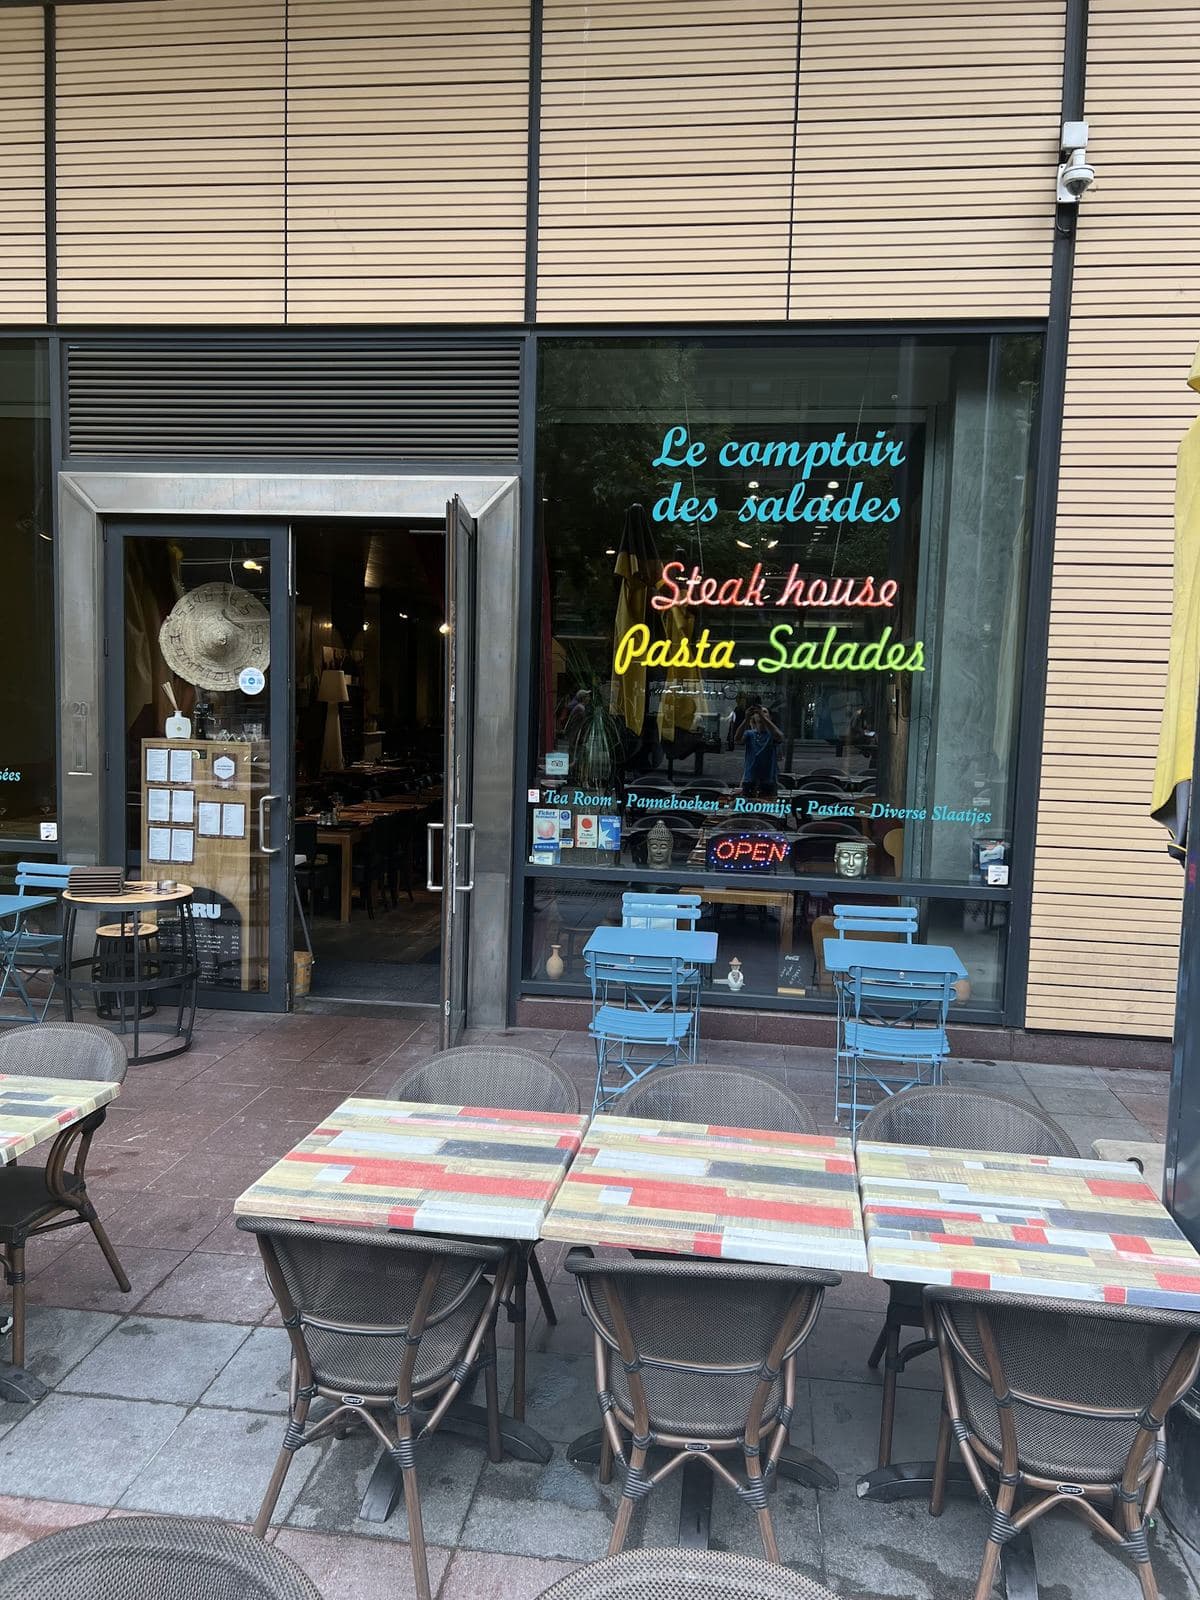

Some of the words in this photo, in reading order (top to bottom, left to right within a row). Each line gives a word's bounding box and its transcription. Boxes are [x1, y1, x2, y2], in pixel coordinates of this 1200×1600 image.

[651, 426, 708, 468] Le
[718, 431, 906, 480] comptoir
[651, 481, 719, 523] des
[738, 481, 901, 523] salades
[651, 561, 767, 611] Steak
[776, 563, 898, 608] house
[614, 624, 737, 675] Pasta
[757, 624, 926, 673] Salades
[545, 789, 569, 805] Tea
[573, 790, 613, 807] Room
[626, 793, 720, 812] Pannekoeken
[734, 797, 792, 818] Roomijs
[806, 800, 855, 817] Pastas
[869, 803, 927, 820] Diverse
[931, 805, 993, 826] Slaatjes
[716, 841, 788, 862] OPEN
